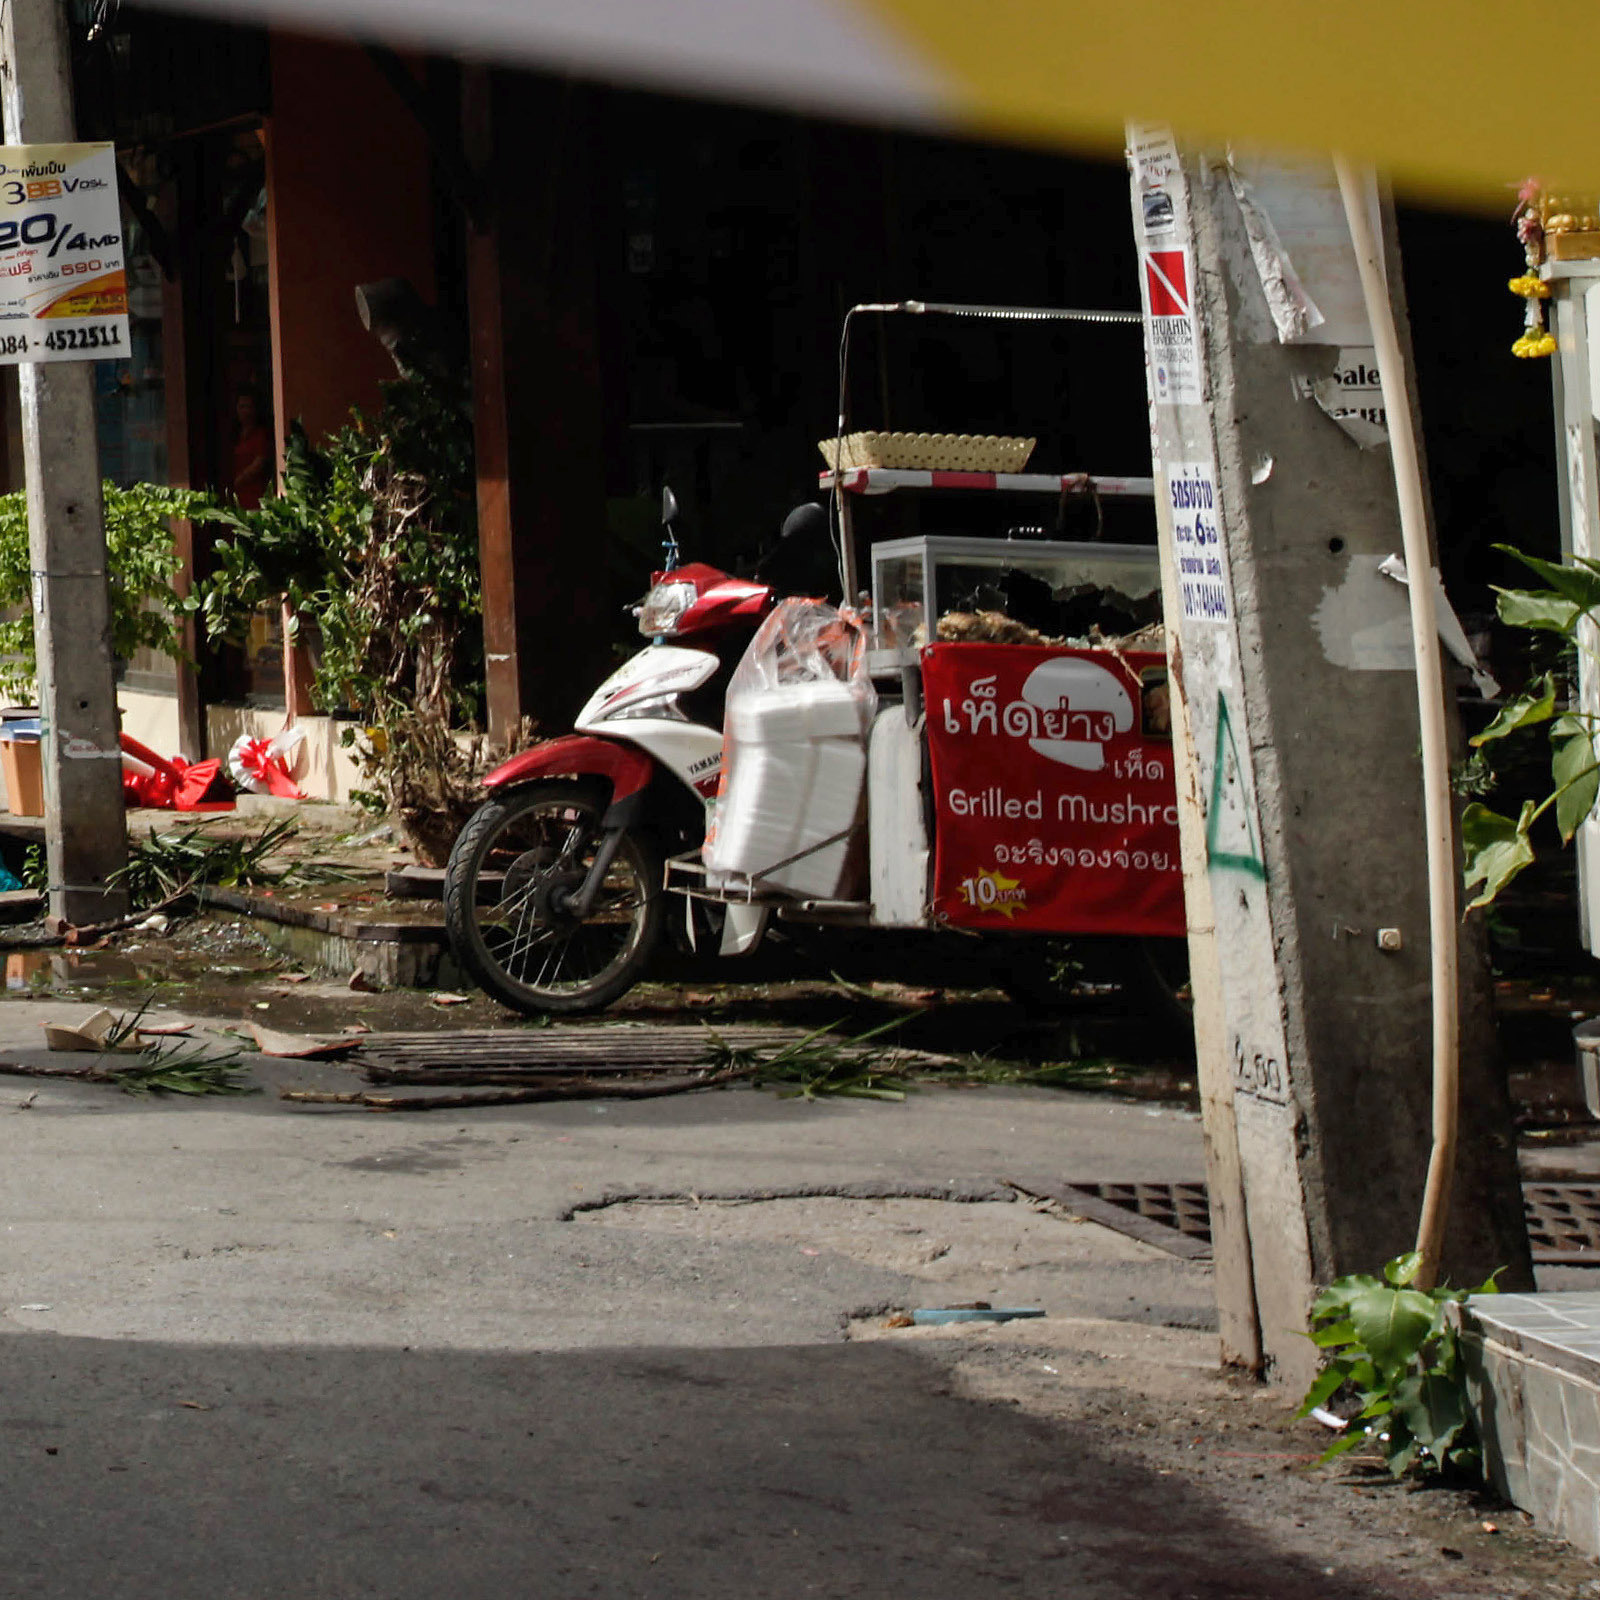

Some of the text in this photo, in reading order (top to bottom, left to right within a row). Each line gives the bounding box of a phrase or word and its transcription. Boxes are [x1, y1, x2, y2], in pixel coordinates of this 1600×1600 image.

[45, 324, 121, 351] 4522511
[1151, 318, 1192, 338] HUAHIN
[1195, 512, 1206, 547] 6
[943, 675, 1115, 742] เห็ดย่าง
[687, 751, 723, 775] YAMAH
[1113, 748, 1164, 781] เห็ด
[948, 786, 1180, 827] Grilled Mushro
[961, 876, 996, 907] 10
